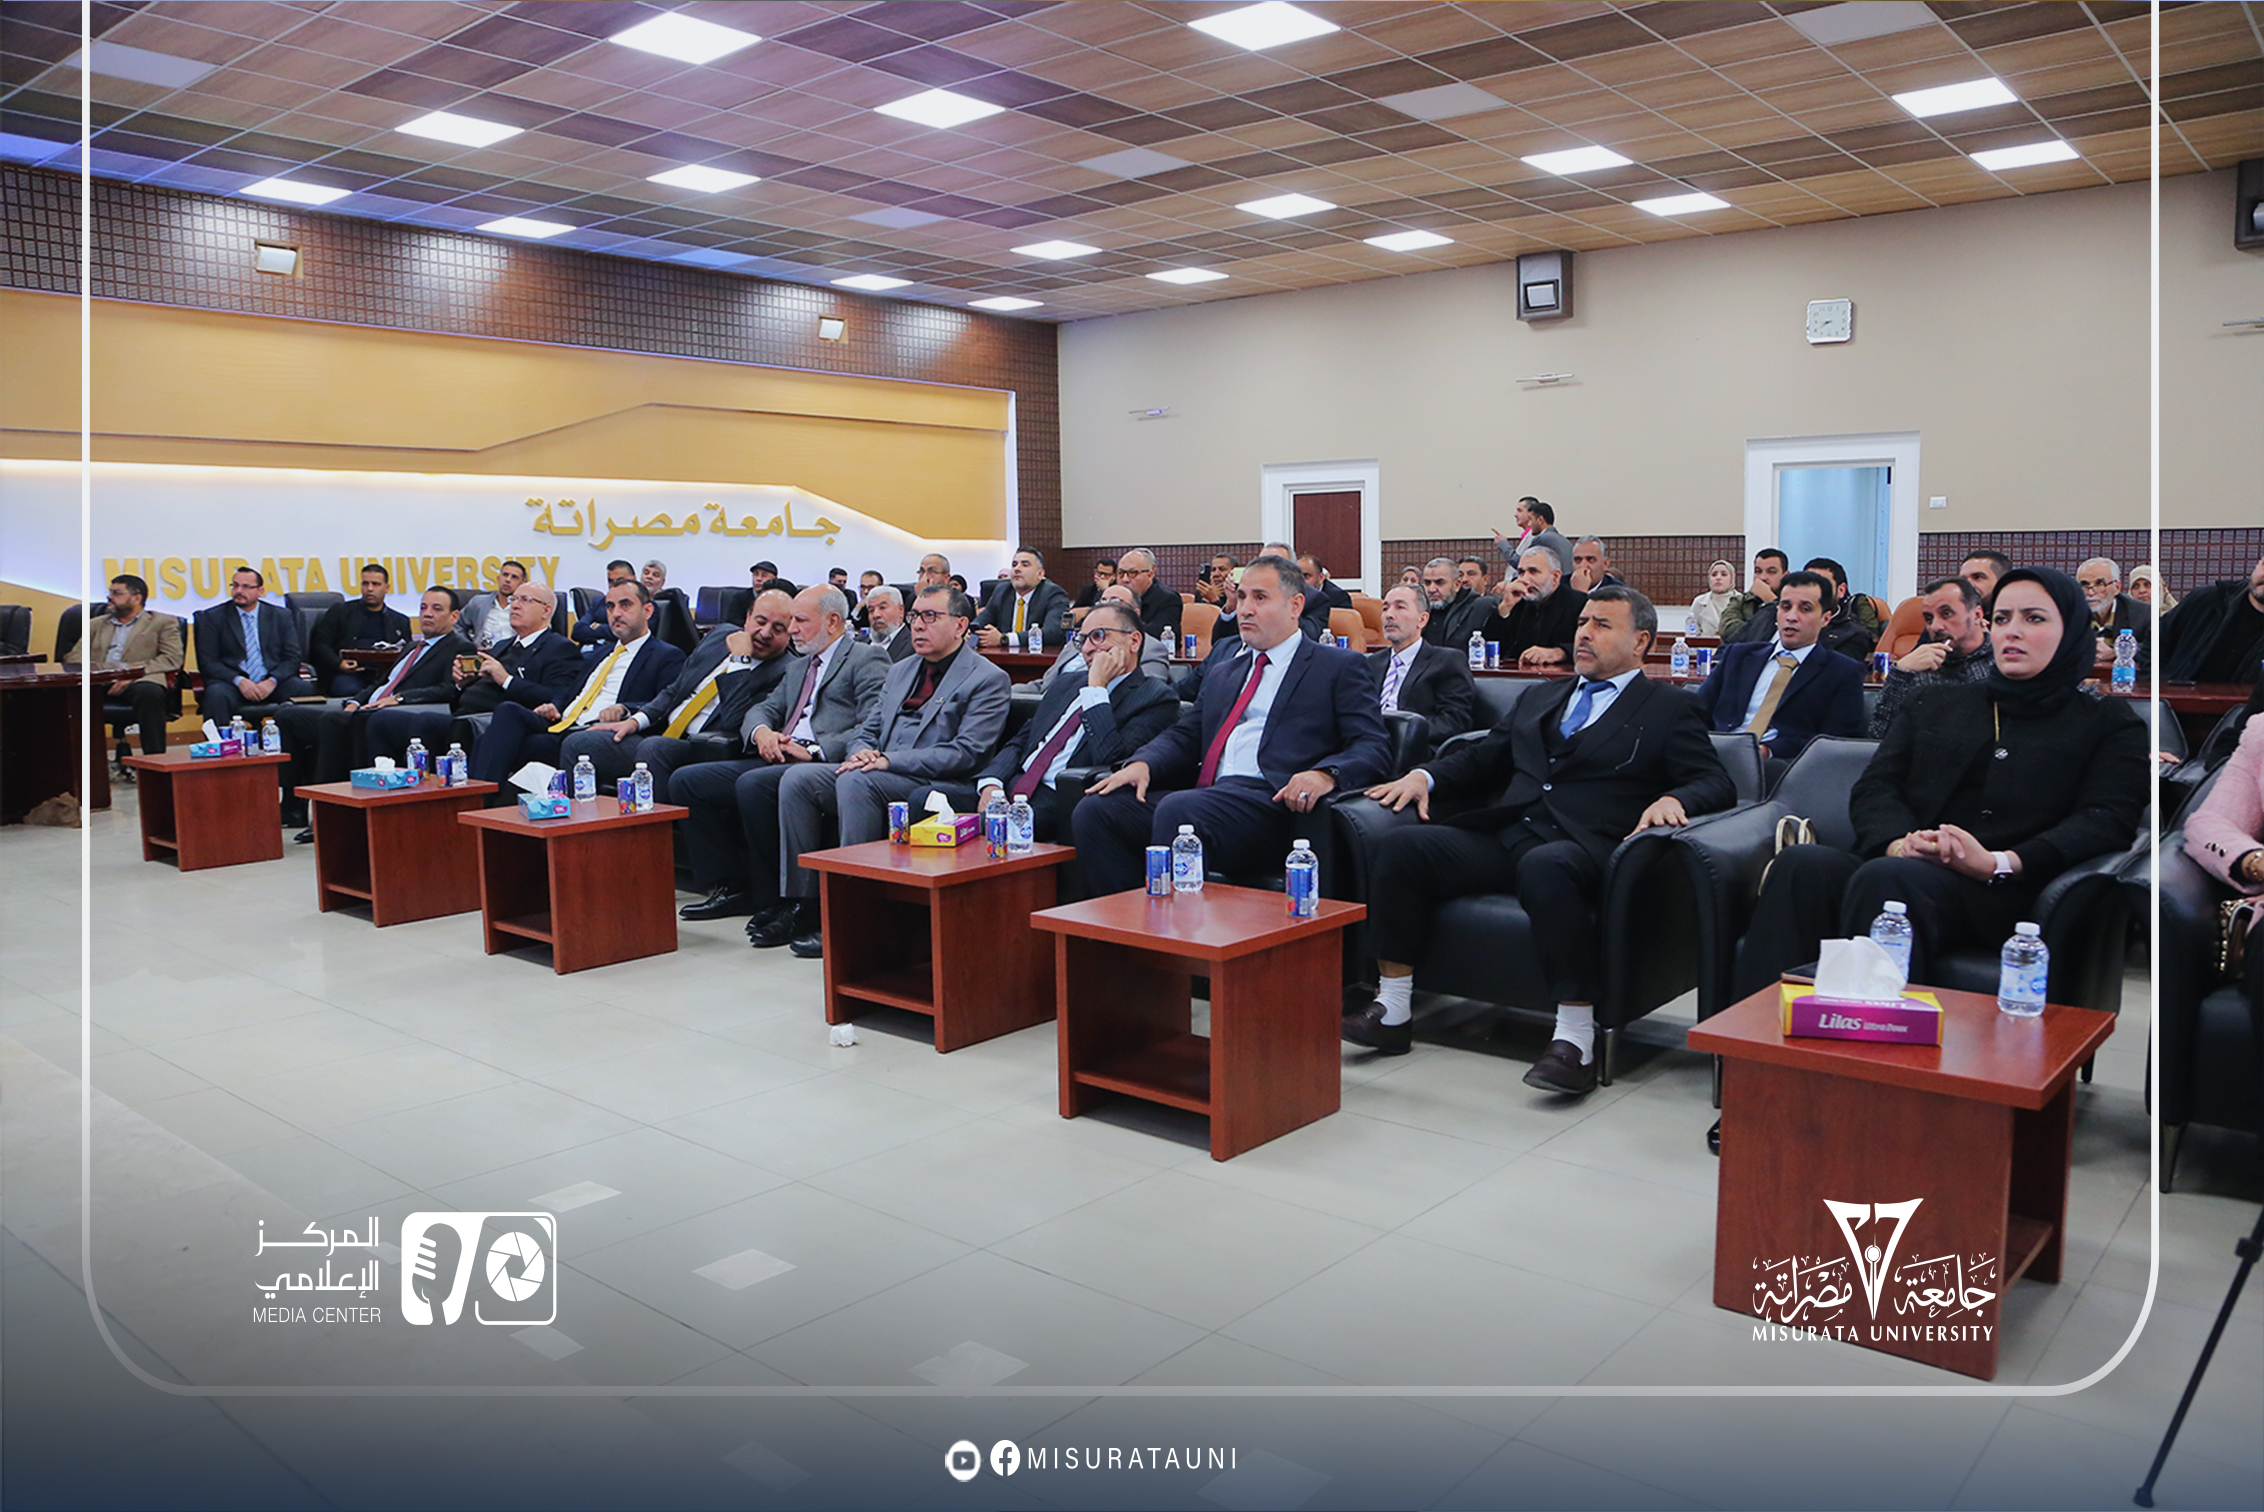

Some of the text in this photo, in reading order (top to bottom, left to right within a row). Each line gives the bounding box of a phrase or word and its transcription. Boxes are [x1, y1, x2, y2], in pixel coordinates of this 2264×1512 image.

[525, 498, 842, 551] جامعة مصراتة
[1818, 1013, 1862, 1031] Lilas
